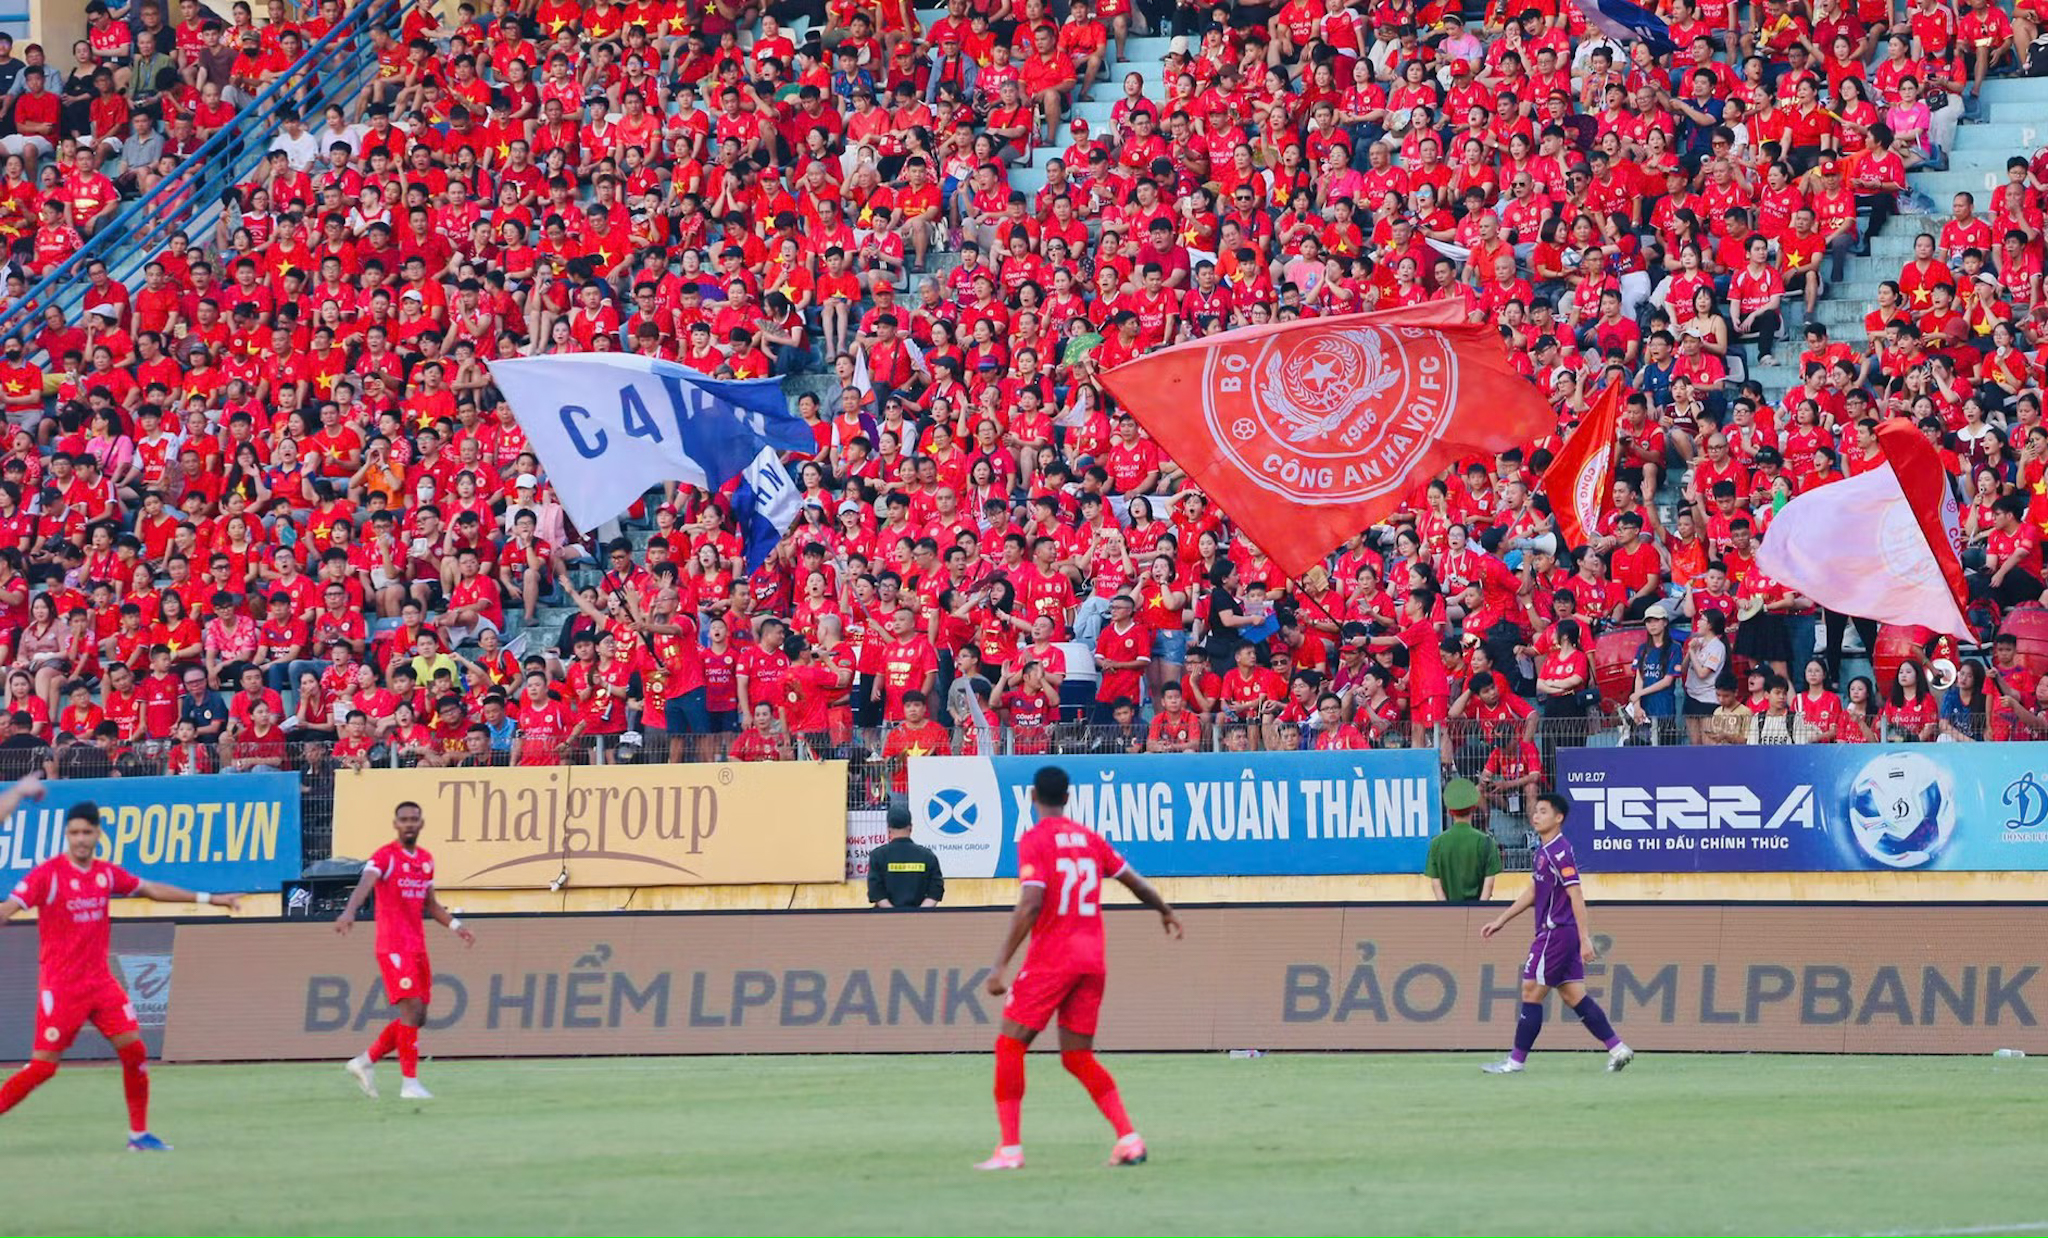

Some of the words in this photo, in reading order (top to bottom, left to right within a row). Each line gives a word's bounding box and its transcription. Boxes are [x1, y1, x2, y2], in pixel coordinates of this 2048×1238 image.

[1262, 452, 1334, 489] CÔNG
[1344, 459, 1383, 488] AN
[1381, 433, 1413, 469] HÀ
[1418, 355, 1441, 390] FC
[1339, 408, 1377, 447] 1956
[1064, 769, 1174, 843] MĂNG
[1185, 769, 1290, 842] XUÂN
[1300, 766, 1429, 839] THÀNH
[1585, 772, 1606, 783] 2.07
[1568, 785, 1814, 831] TERRA
[1593, 836, 1633, 851] BÓNG
[1637, 838, 1660, 850] THI
[1665, 833, 1695, 850] ĐẤU
[1700, 835, 1746, 851] CHÍNH
[1751, 834, 1789, 851] THỨC
[1056, 857, 1098, 917] 72
[487, 944, 671, 1030] HIỂM
[689, 970, 993, 1031] LPBANK
[1283, 939, 1458, 1023] BẢO
[1701, 964, 2040, 1028] LPBANK
